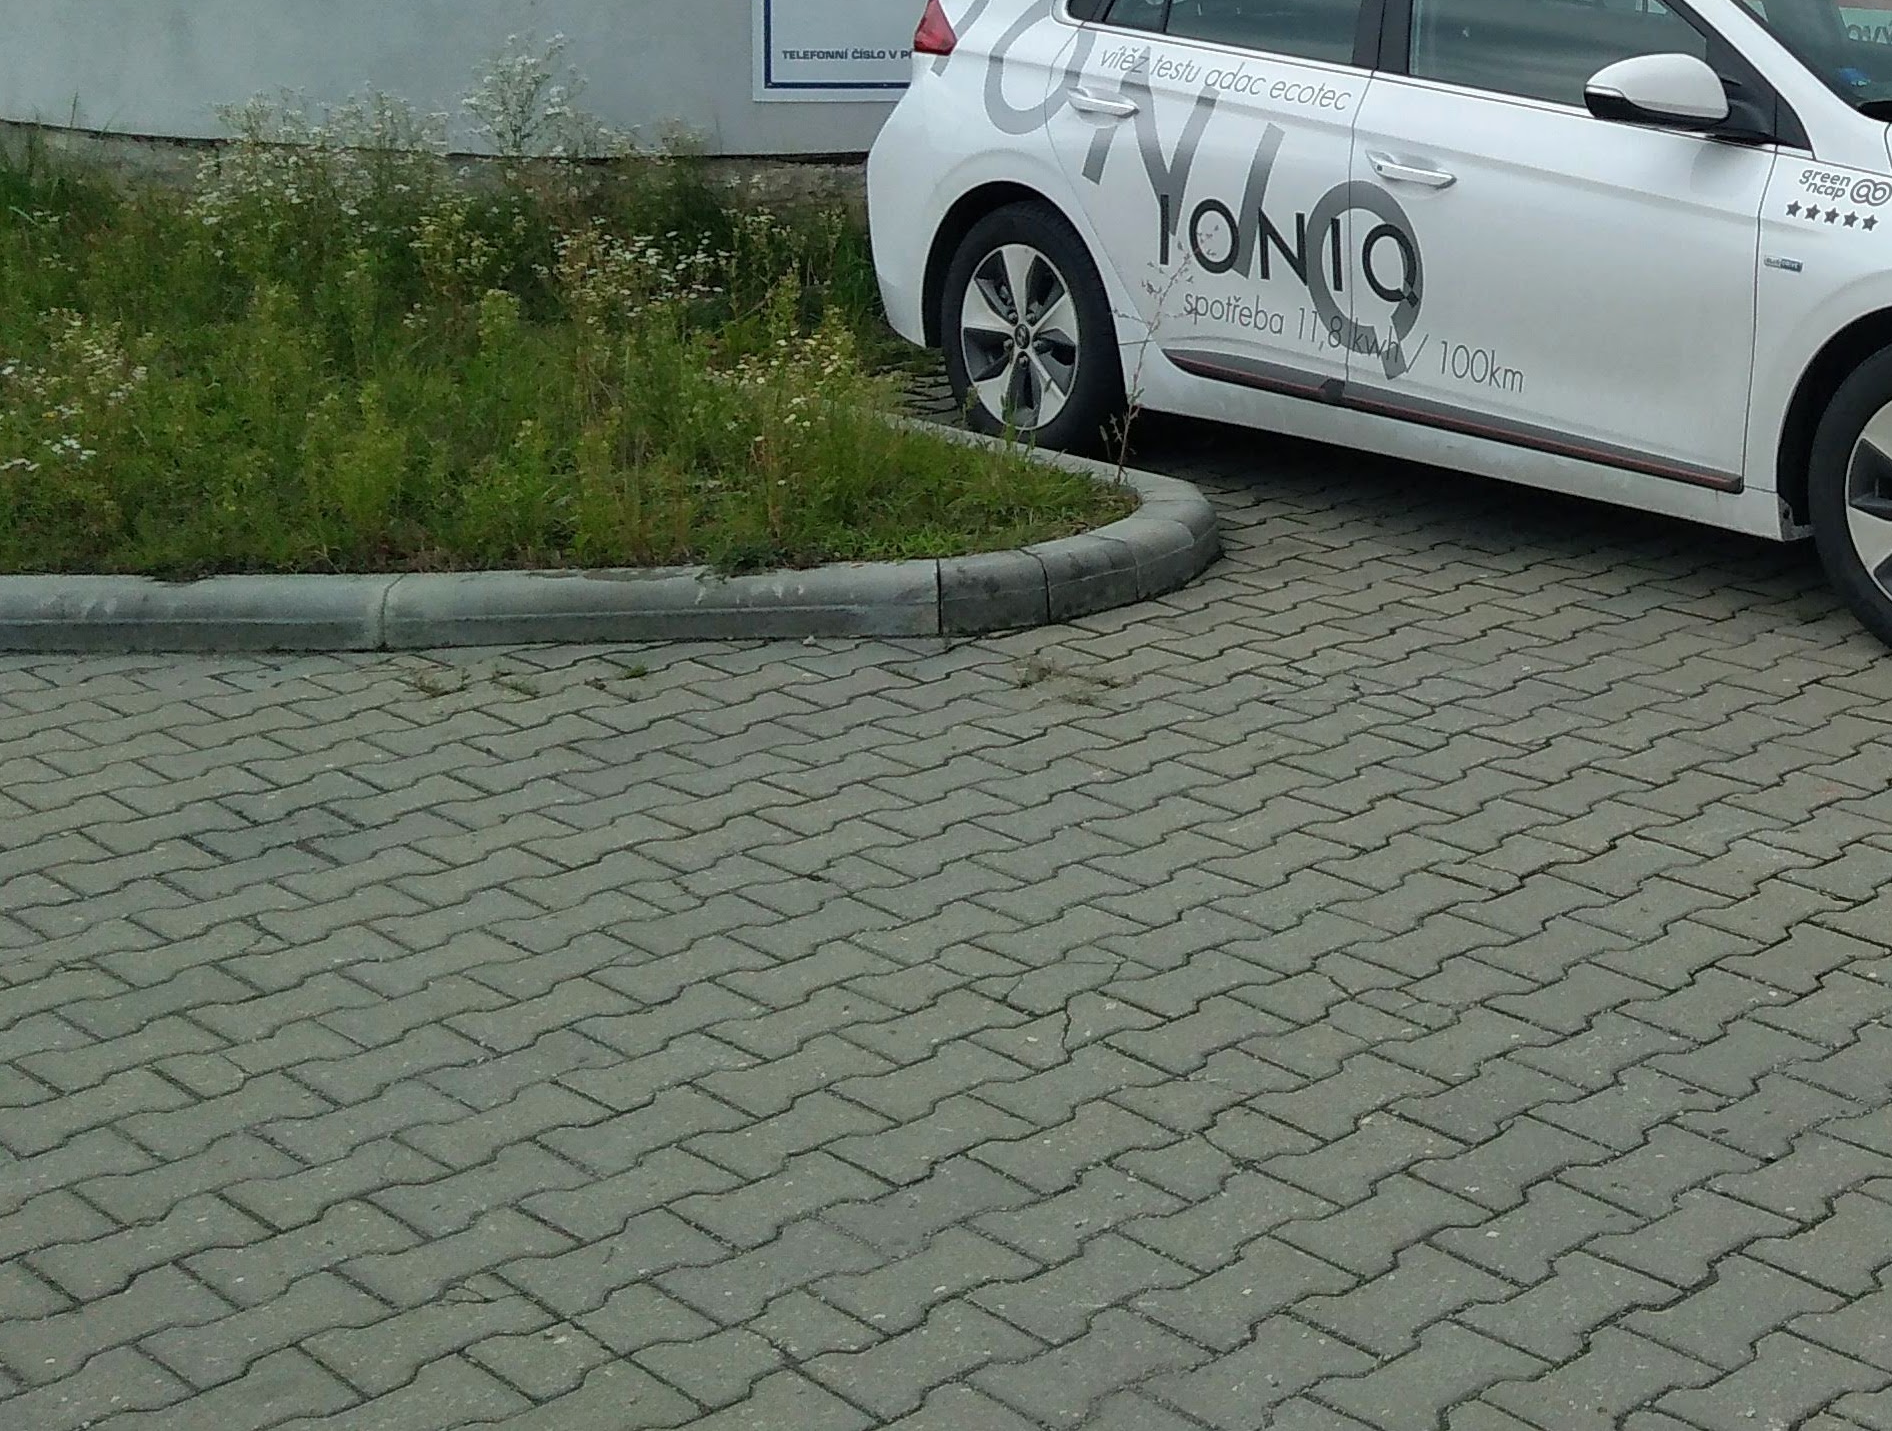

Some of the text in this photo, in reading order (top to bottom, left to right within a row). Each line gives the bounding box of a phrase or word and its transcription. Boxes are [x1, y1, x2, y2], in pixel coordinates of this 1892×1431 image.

[781, 48, 849, 60] TELEFONNÍ
[851, 48, 886, 60] ČÍSLO
[888, 50, 898, 60] V
[1100, 45, 1352, 111] vítěz testu adac ecotec
[1798, 169, 1852, 187] green
[1805, 182, 1846, 201] ncap
[1158, 194, 1419, 308] IONIQ
[1183, 292, 1285, 335] spotřeba
[1298, 307, 1342, 351] 11,8
[1440, 340, 1524, 393] 100km
